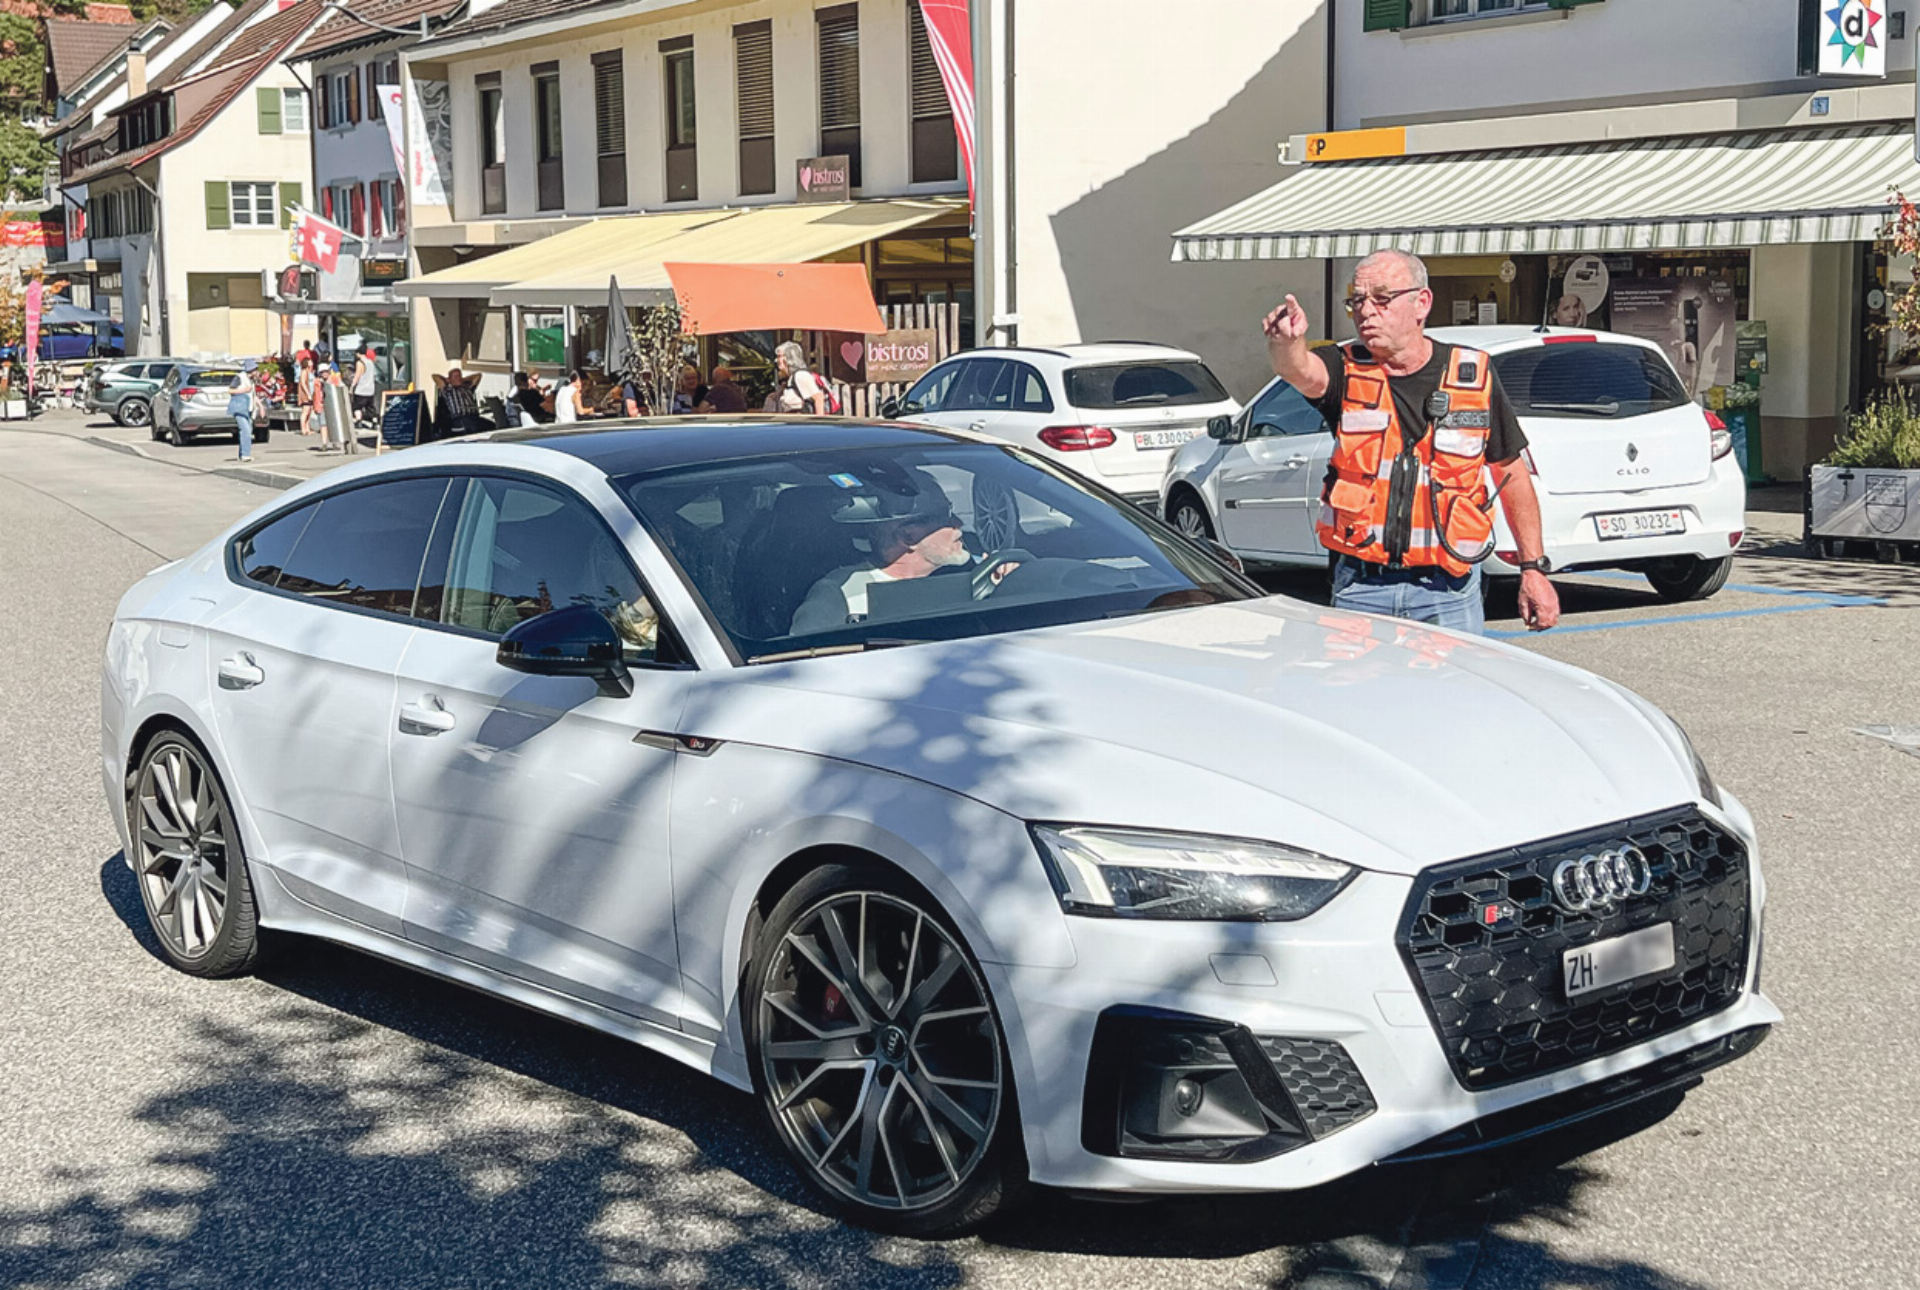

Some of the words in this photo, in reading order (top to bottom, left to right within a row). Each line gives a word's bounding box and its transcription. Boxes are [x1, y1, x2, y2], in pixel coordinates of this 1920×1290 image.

[1844, 8, 1863, 37] d
[813, 167, 845, 184] bistrosi
[867, 342, 929, 361] bistrosi
[1616, 467, 1650, 476] CLIO
[1611, 517, 1627, 532] SO
[1633, 513, 1671, 530] 30232
